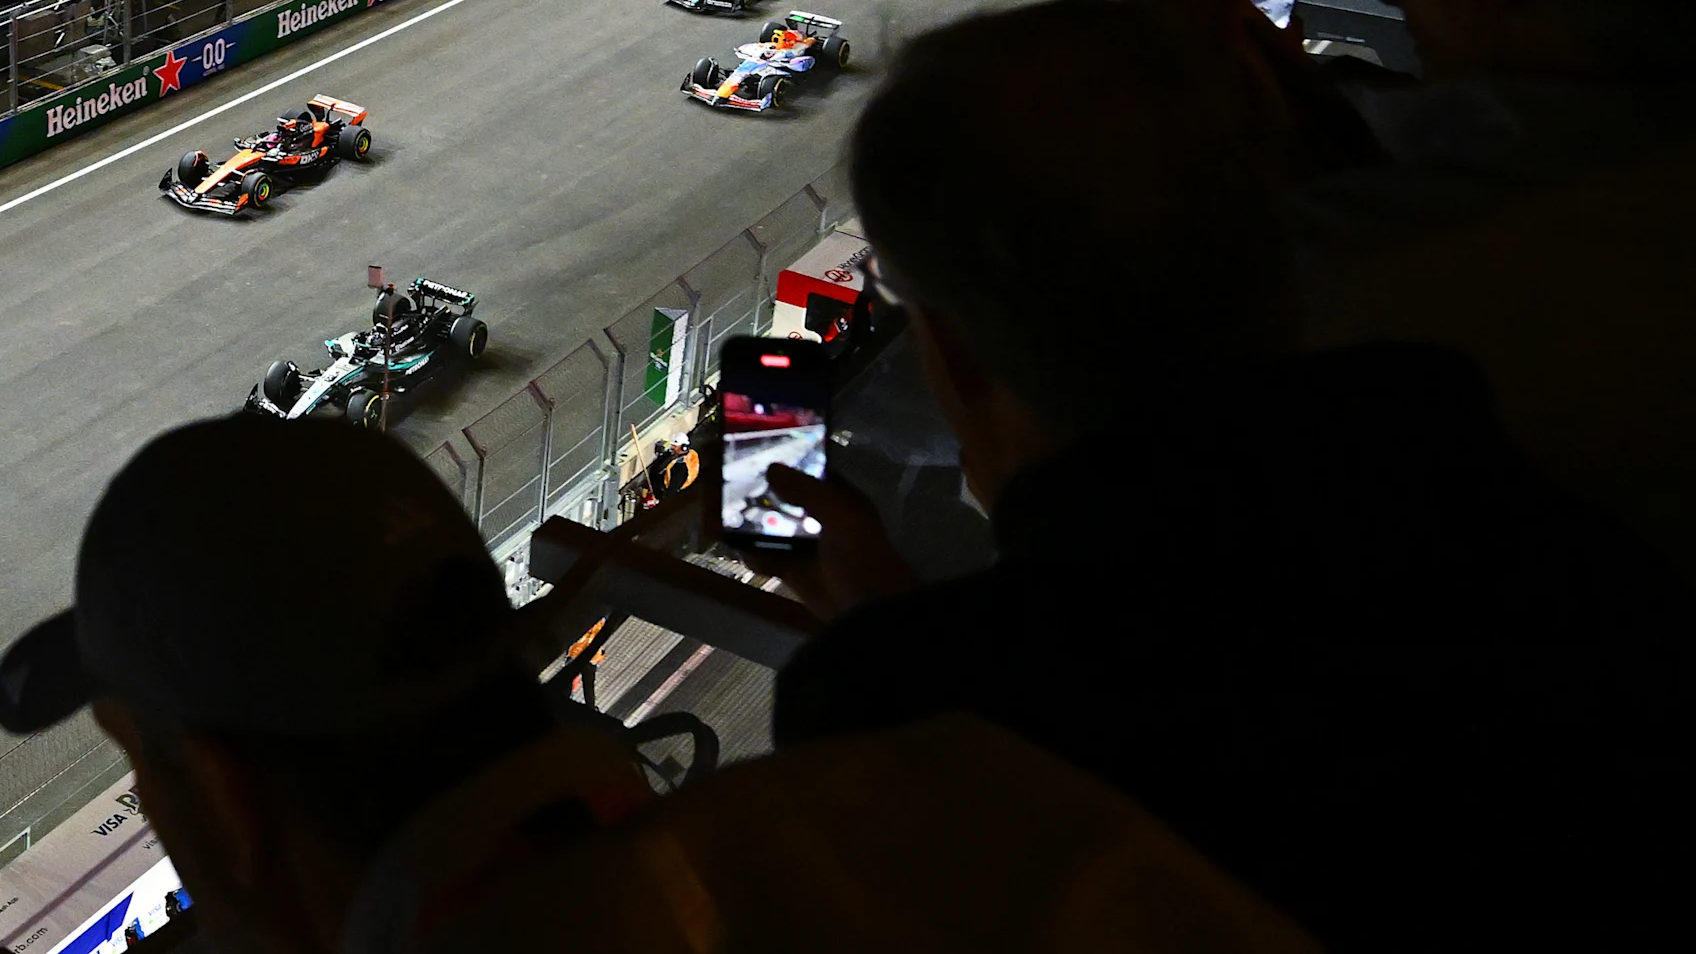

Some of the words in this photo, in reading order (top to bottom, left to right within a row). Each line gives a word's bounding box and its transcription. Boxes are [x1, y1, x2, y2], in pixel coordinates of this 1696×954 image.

[46, 76, 148, 138] Heineken
[203, 38, 226, 70] 0.0
[422, 280, 468, 298] PETRONAS
[91, 814, 128, 836] VISA
